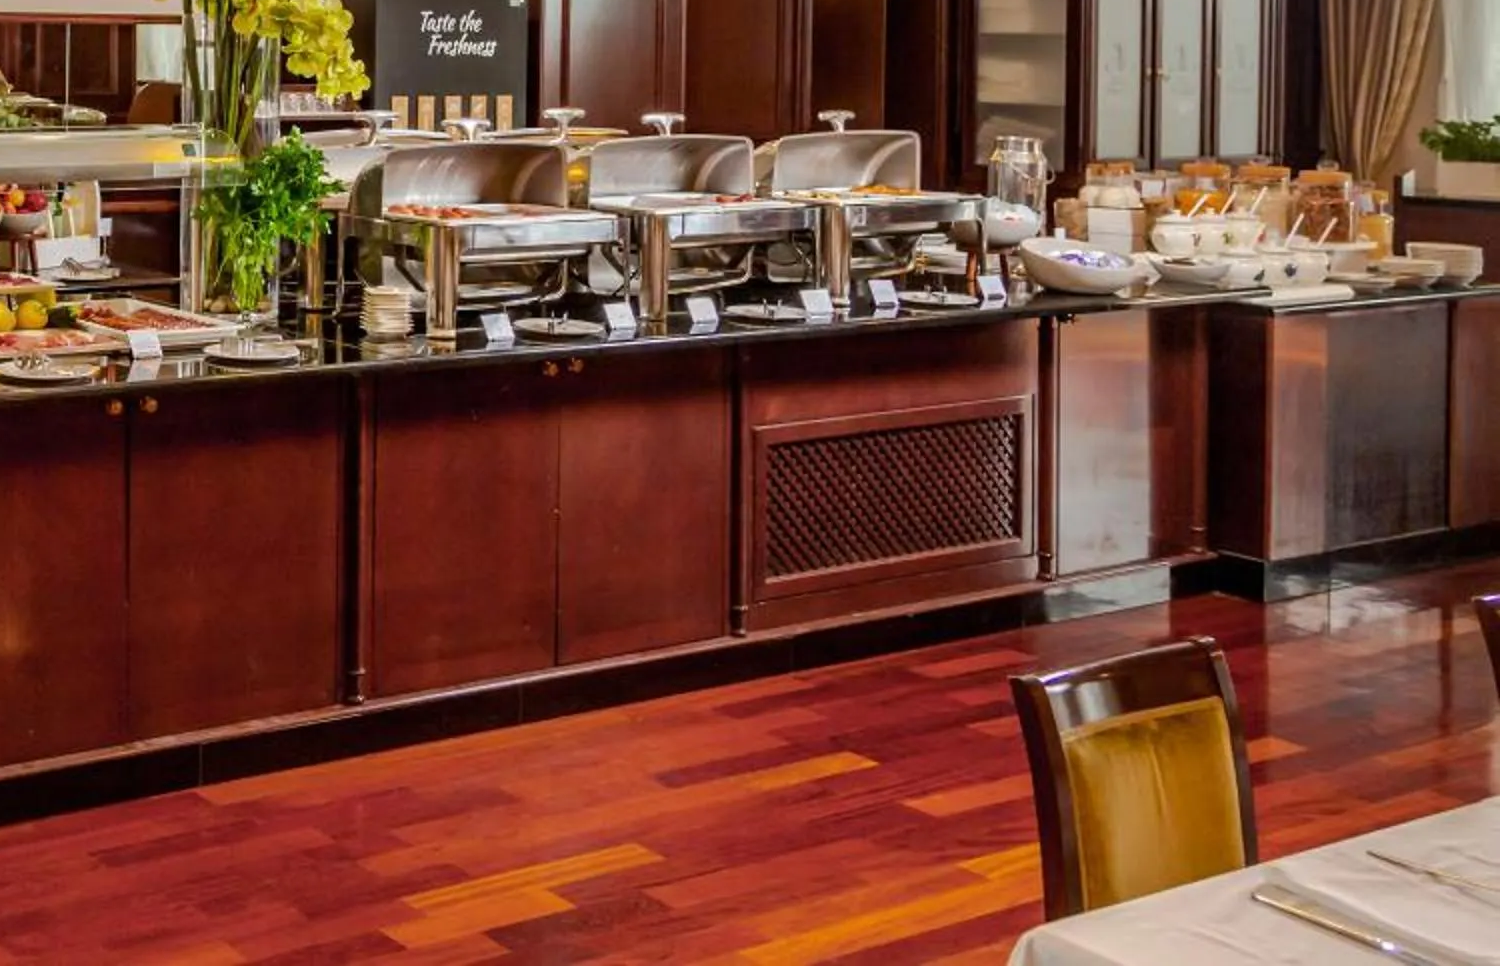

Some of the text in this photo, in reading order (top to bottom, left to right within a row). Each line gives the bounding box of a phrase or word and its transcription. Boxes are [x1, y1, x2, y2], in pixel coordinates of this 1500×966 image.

[420, 9, 483, 33] Taste the
[427, 33, 497, 57] Freshness
